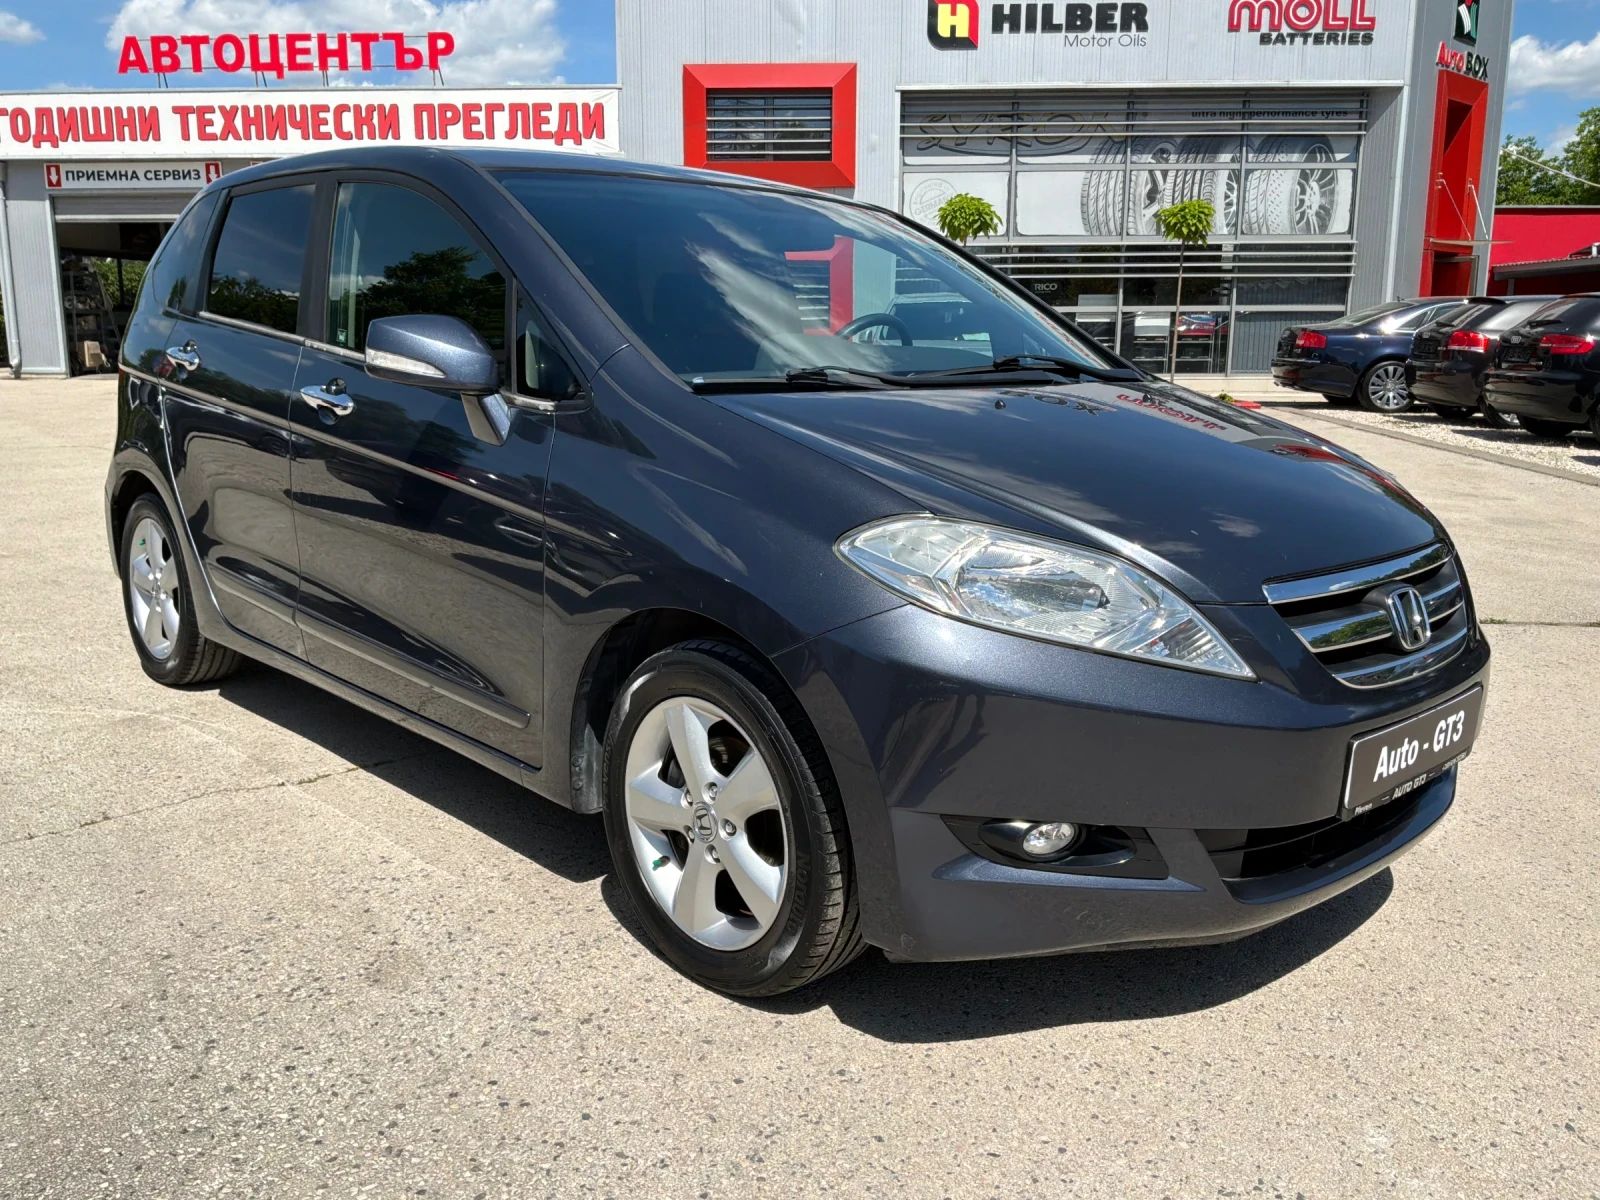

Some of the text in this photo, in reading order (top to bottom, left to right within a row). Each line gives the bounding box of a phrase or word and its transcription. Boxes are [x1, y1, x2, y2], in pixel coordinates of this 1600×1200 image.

[991, 3, 1149, 34] HILBER
[1064, 34, 1147, 47] Motor Oils
[1259, 32, 1374, 46] BATTERIES
[117, 31, 456, 80] АВТОЦЕНТЪР
[1464, 50, 1490, 81] BOX
[172, 103, 400, 142] ТЕХНИЧЕСКИ
[413, 102, 606, 146] ПРЕГЛЕДИ
[65, 169, 202, 182] ПРИЕМНА СЕРВИЗ
[1373, 737, 1419, 783] Auto
[1433, 710, 1465, 752] GT3
[1392, 773, 1427, 800] AUTO GT3
